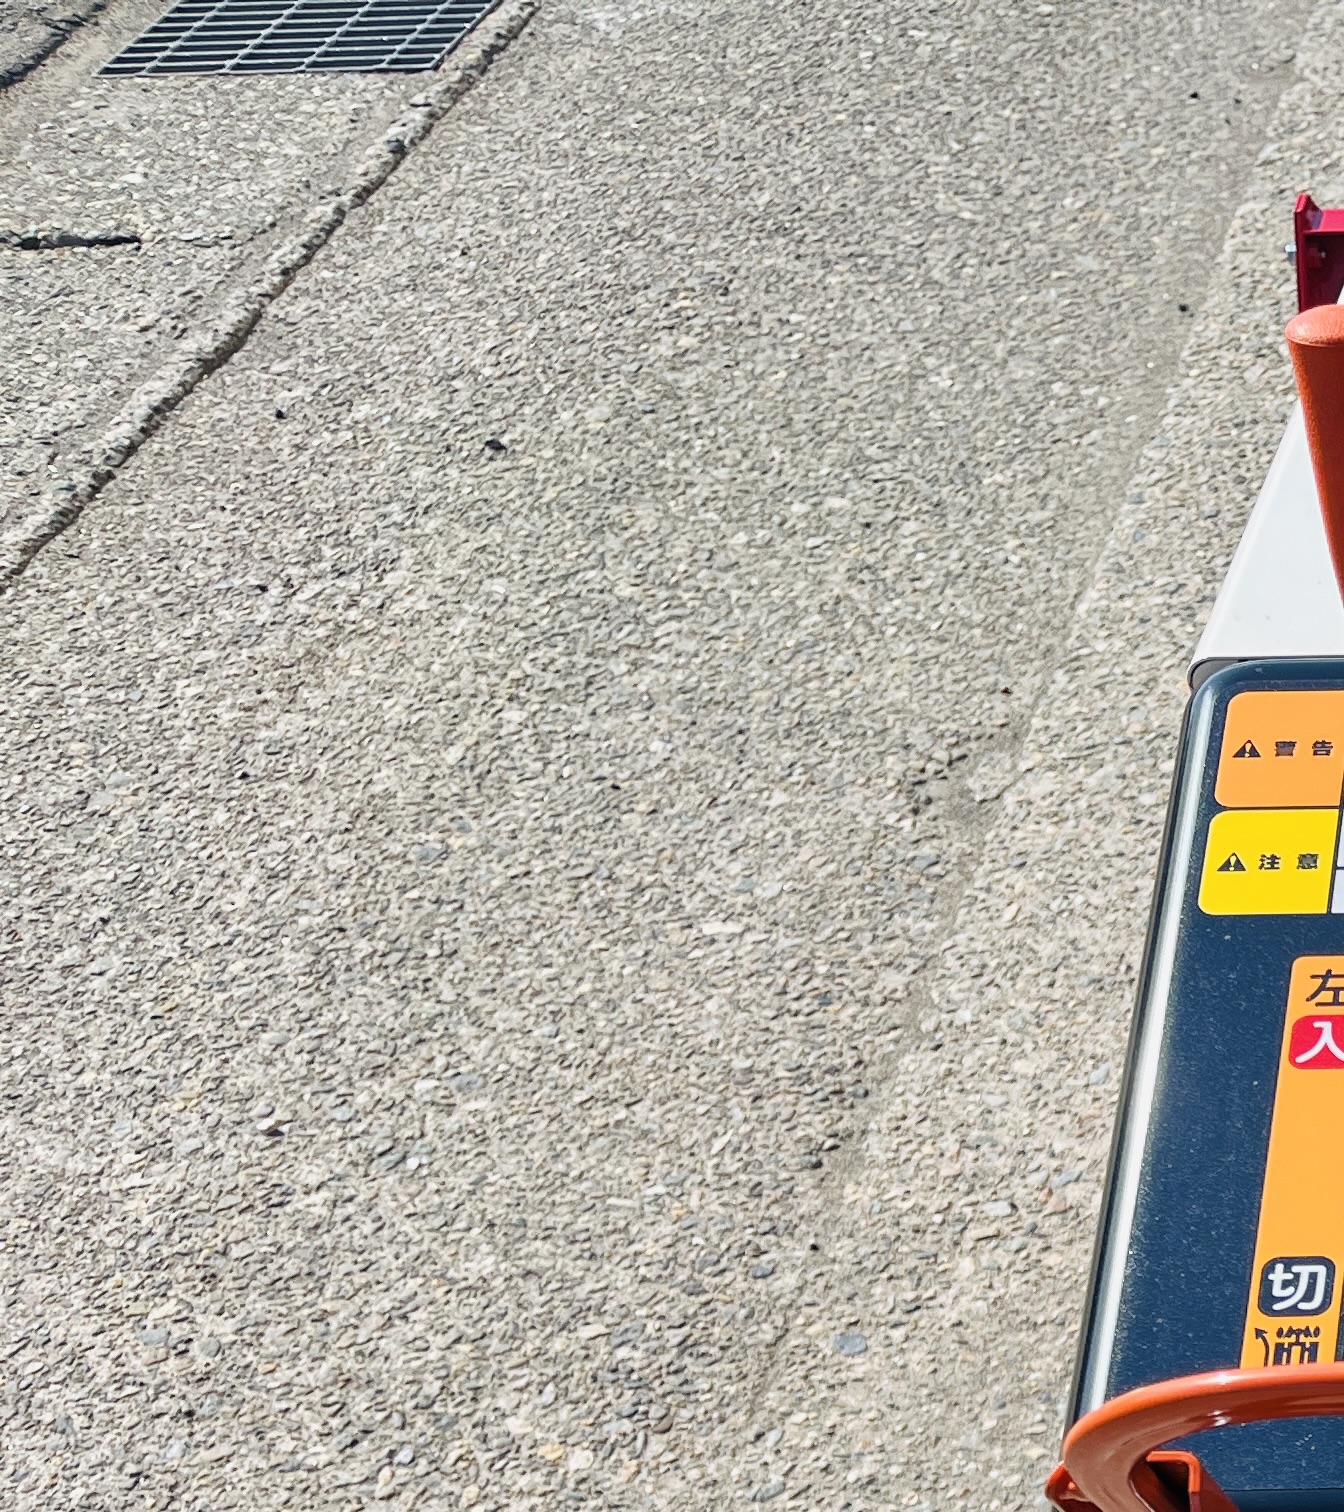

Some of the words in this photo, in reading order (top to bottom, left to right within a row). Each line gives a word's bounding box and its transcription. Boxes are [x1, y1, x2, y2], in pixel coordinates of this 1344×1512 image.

[1275, 739, 1334, 758] 警告
[1258, 852, 1319, 871] 注意
[1267, 1264, 1327, 1310] 切
